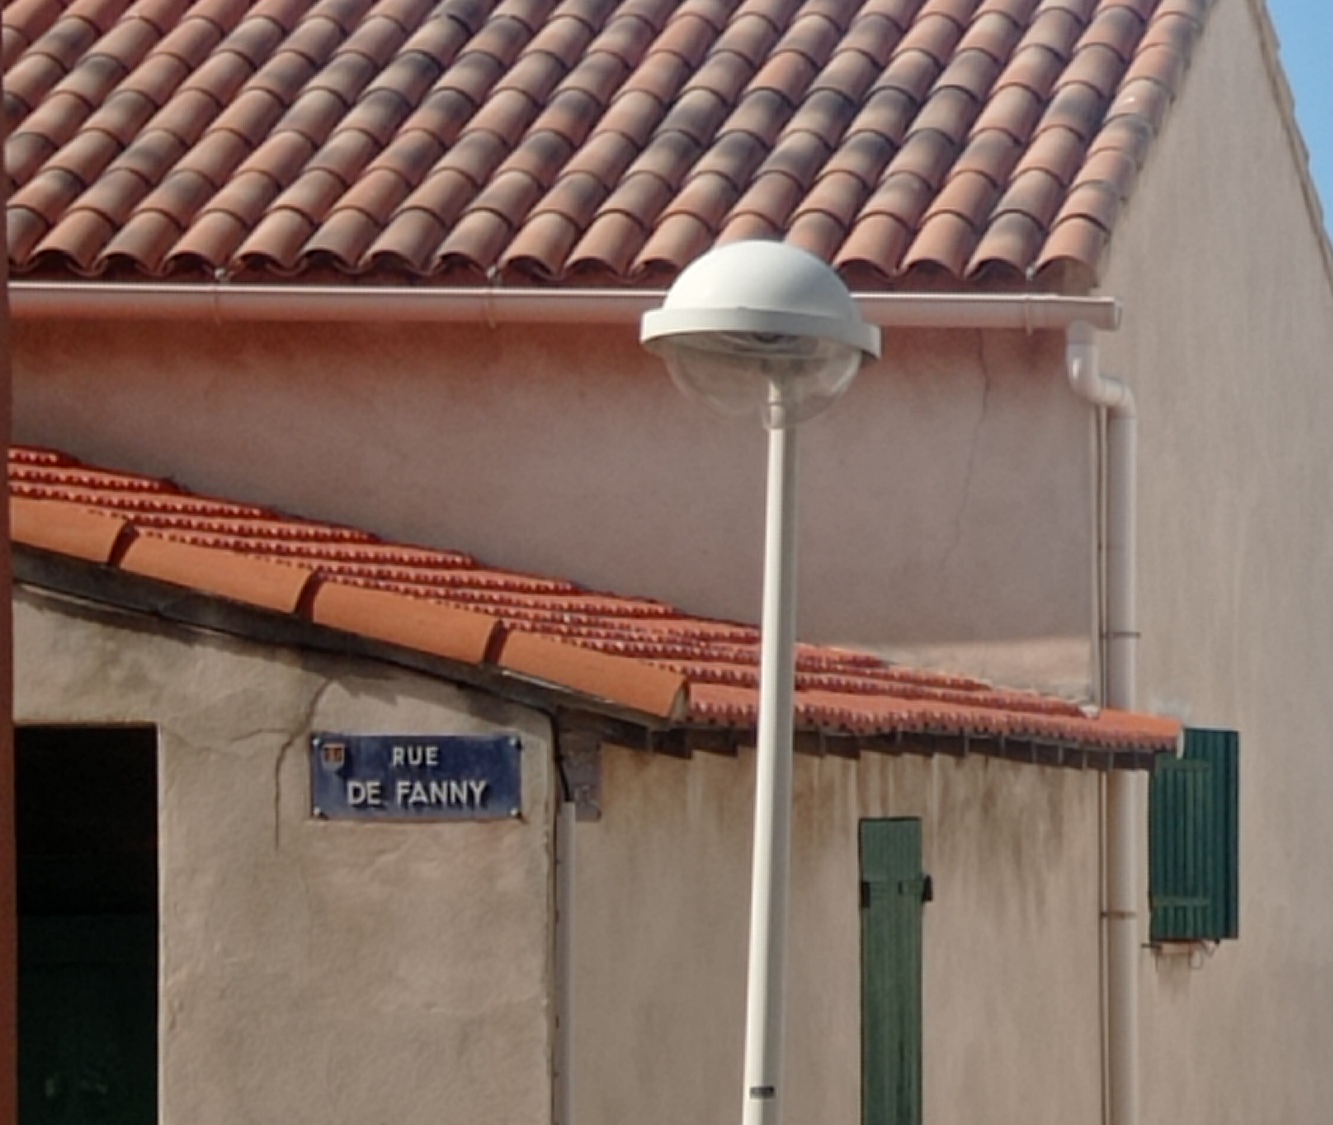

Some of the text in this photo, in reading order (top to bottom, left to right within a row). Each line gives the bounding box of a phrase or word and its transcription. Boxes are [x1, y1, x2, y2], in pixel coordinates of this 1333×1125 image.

[392, 746, 438, 766] RUE
[347, 780, 487, 804] DE FANNY
